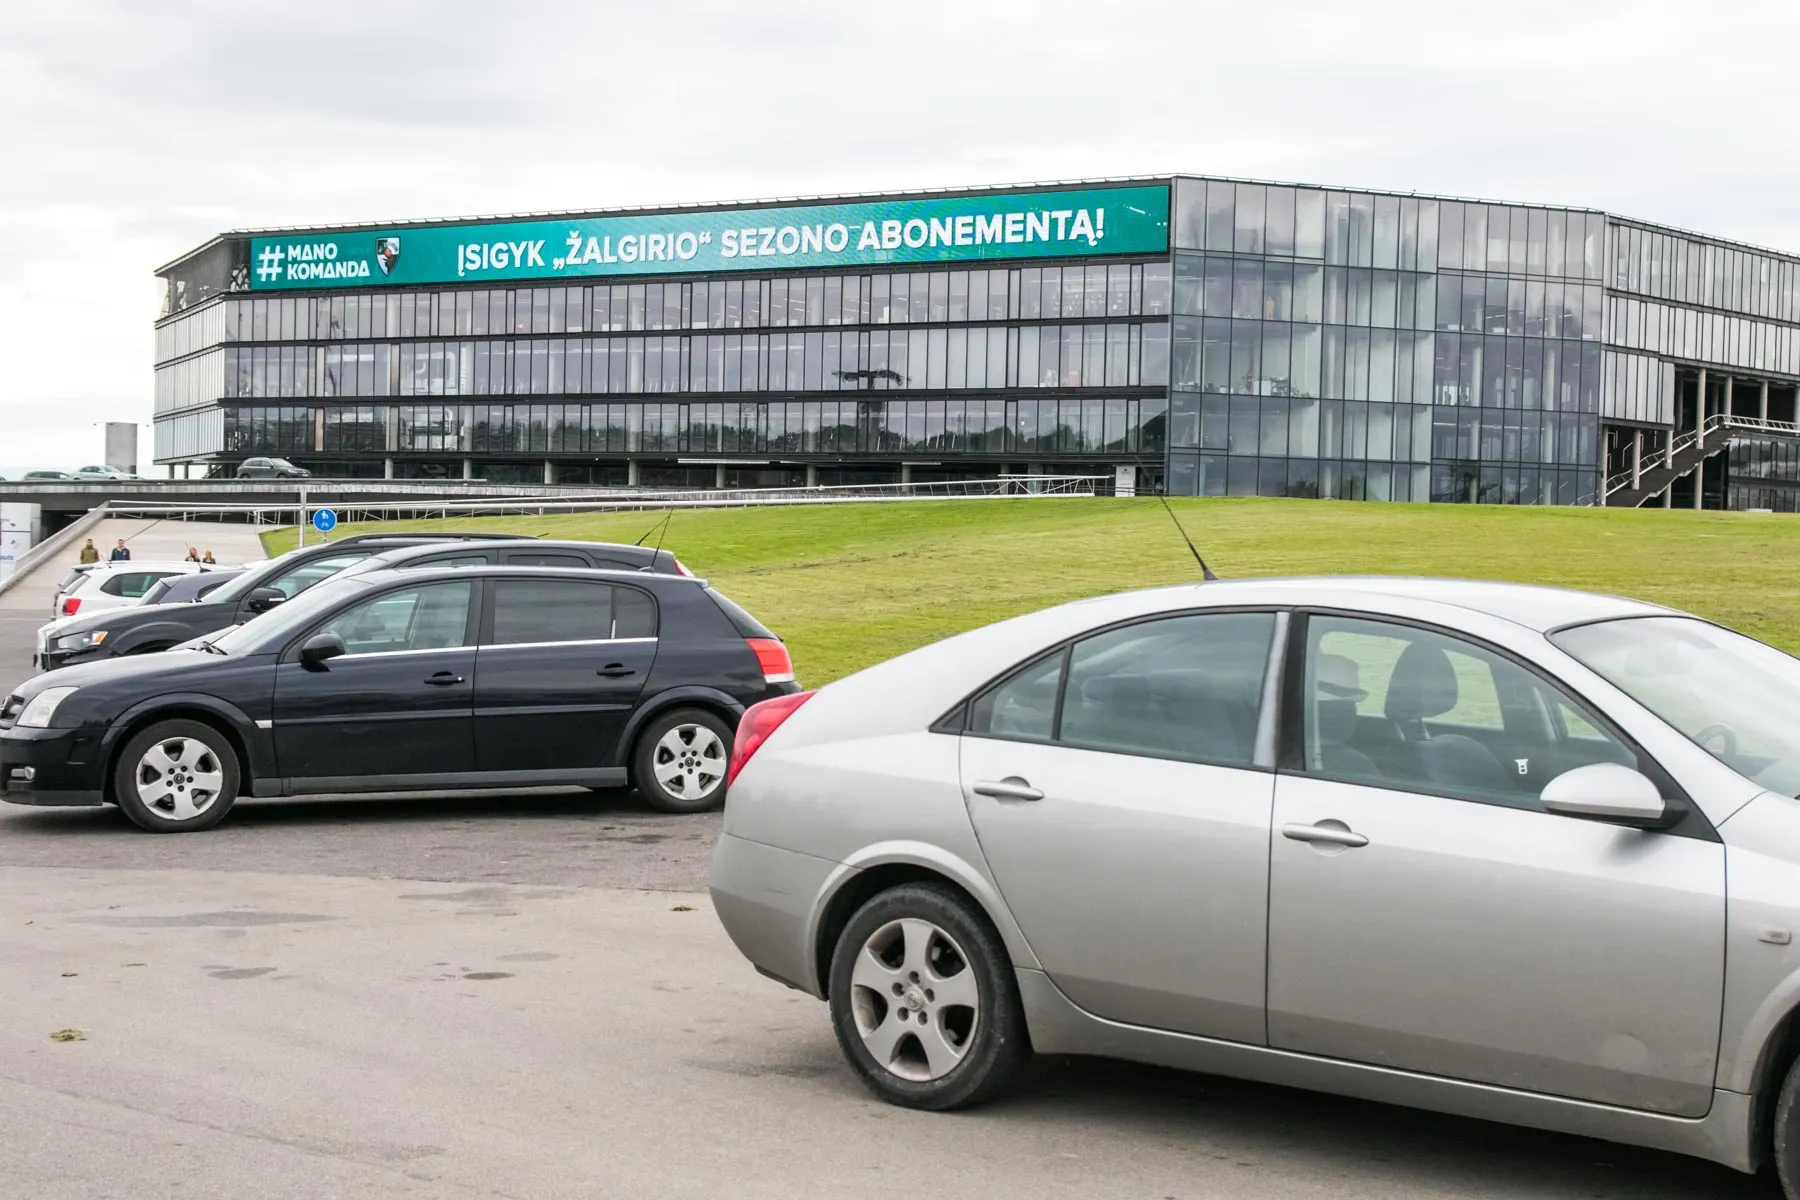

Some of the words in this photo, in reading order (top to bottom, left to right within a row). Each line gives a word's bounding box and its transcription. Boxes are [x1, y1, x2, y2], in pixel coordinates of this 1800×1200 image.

[287, 243, 338, 261] MANO
[458, 240, 546, 277] ĮSIGYK
[720, 223, 849, 258] SEZONO
[856, 208, 1105, 251] ABONEMENTĄ!
[287, 260, 370, 280] KOMANDA
